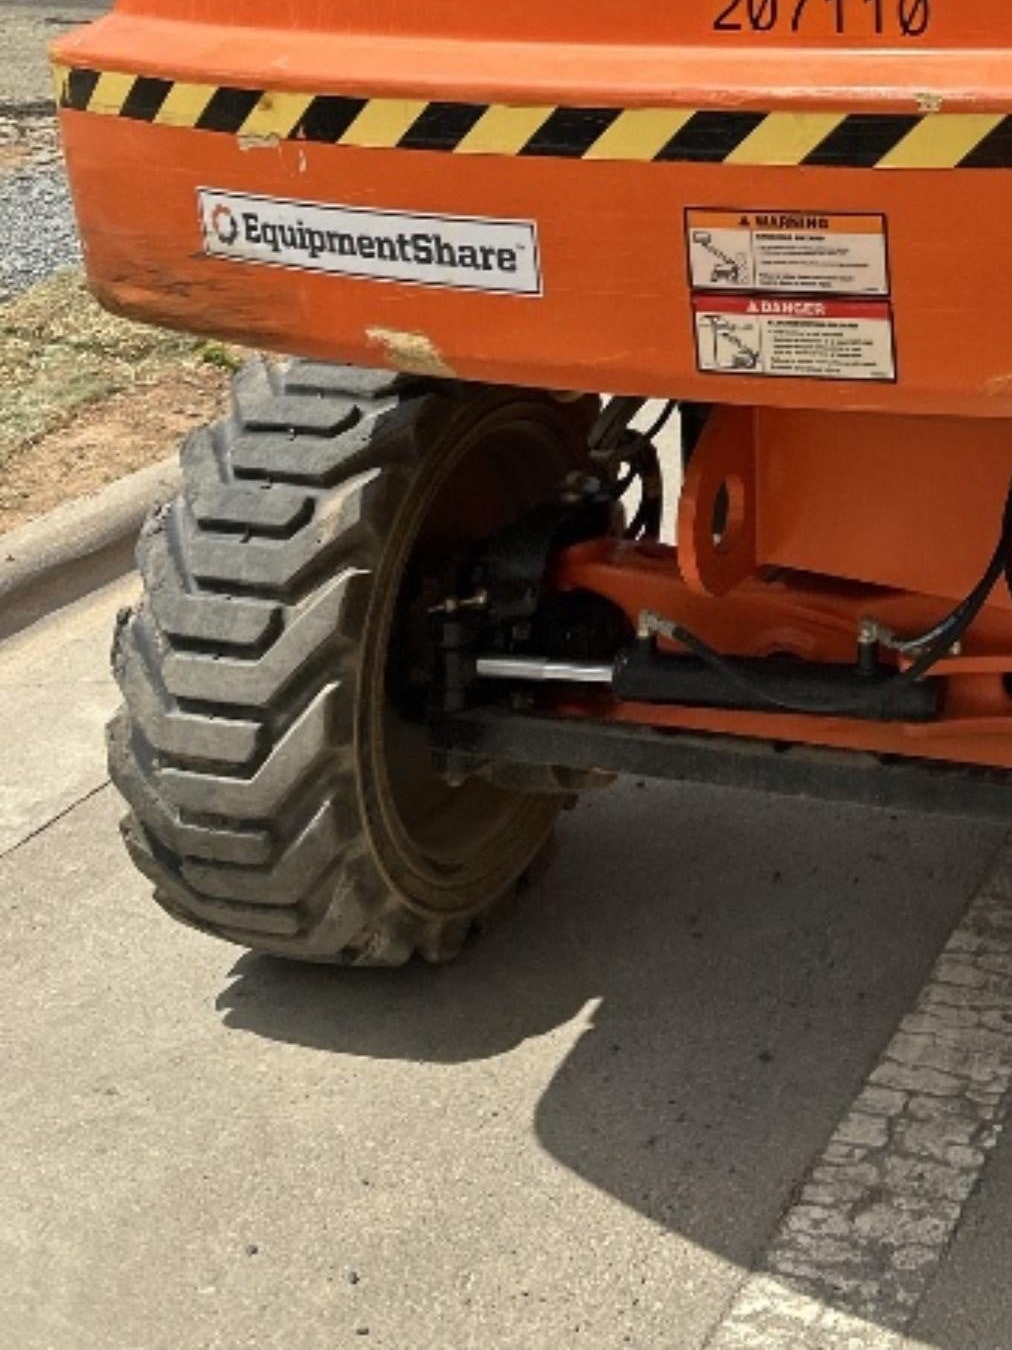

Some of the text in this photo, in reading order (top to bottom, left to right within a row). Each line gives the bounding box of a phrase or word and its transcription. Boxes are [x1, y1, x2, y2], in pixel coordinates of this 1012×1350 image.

[755, 215, 829, 229] WARNING
[241, 212, 518, 273] EquipmentShare
[760, 301, 826, 316] DANGER
